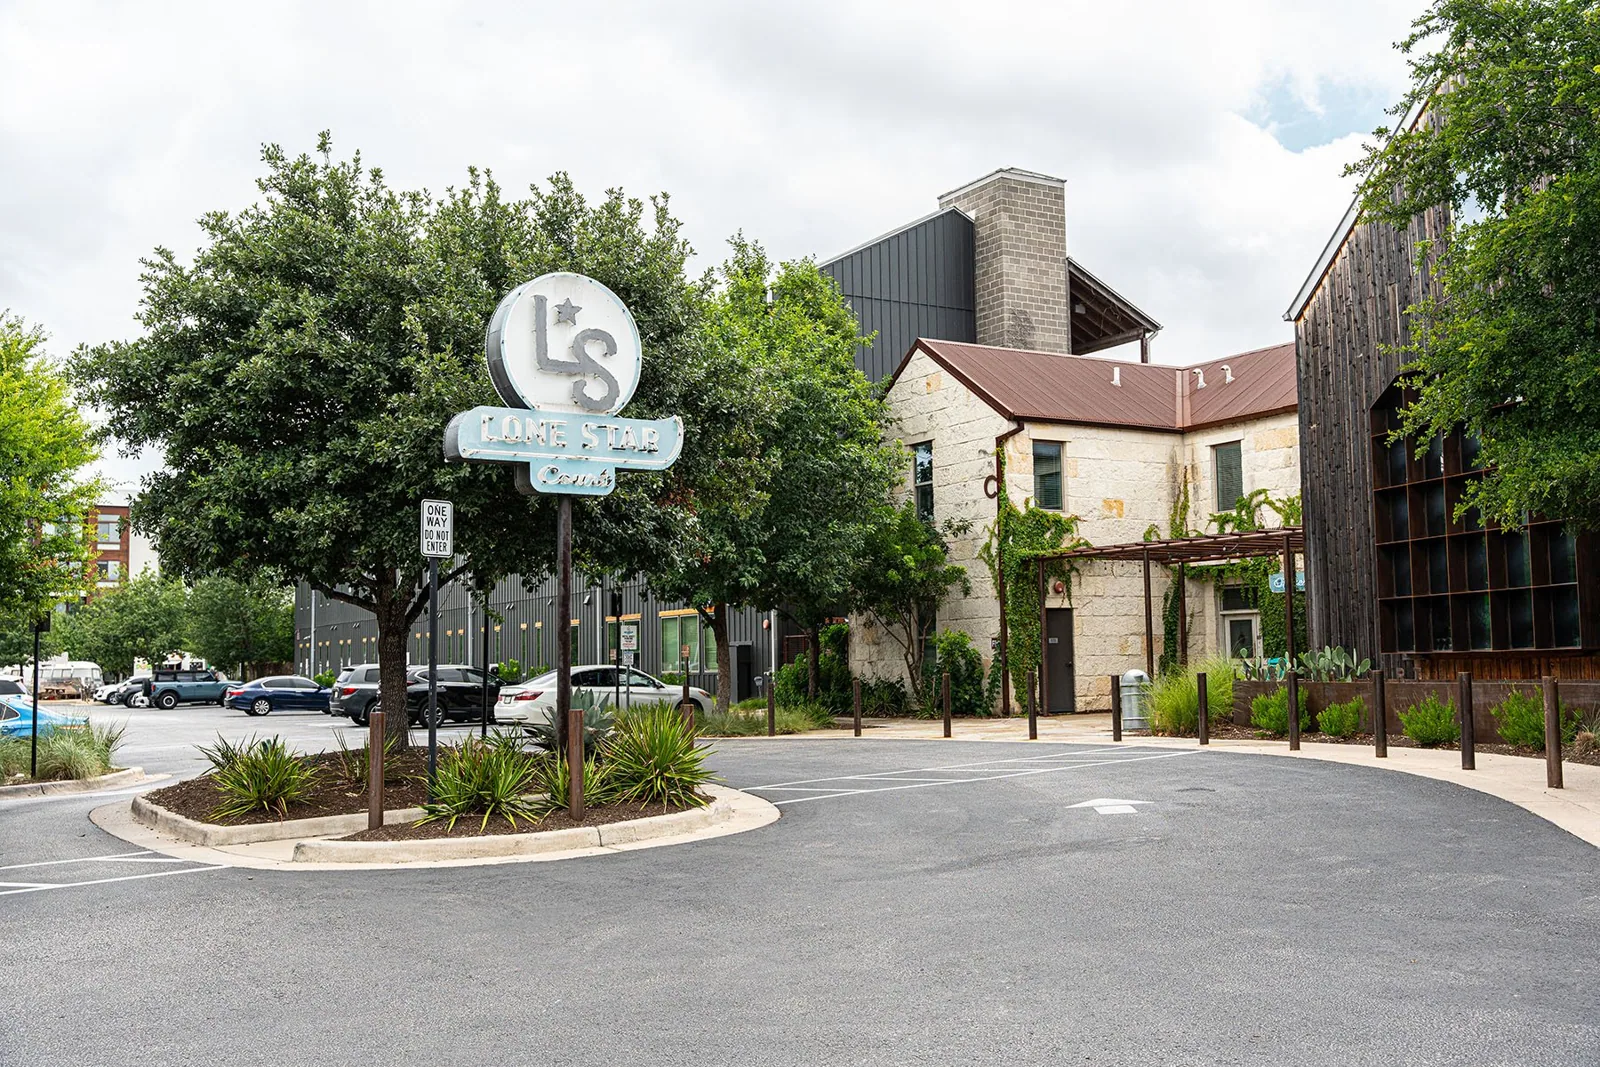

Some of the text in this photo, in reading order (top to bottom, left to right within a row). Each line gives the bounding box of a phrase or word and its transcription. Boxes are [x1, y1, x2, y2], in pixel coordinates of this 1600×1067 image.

[532, 294, 621, 412] LS
[480, 413, 661, 454] LONE STAR
[537, 464, 613, 488] Court
[427, 504, 447, 517] ONE
[426, 516, 448, 528] WAY
[424, 529, 450, 541] DO NOT
[426, 540, 448, 552] ENTER
